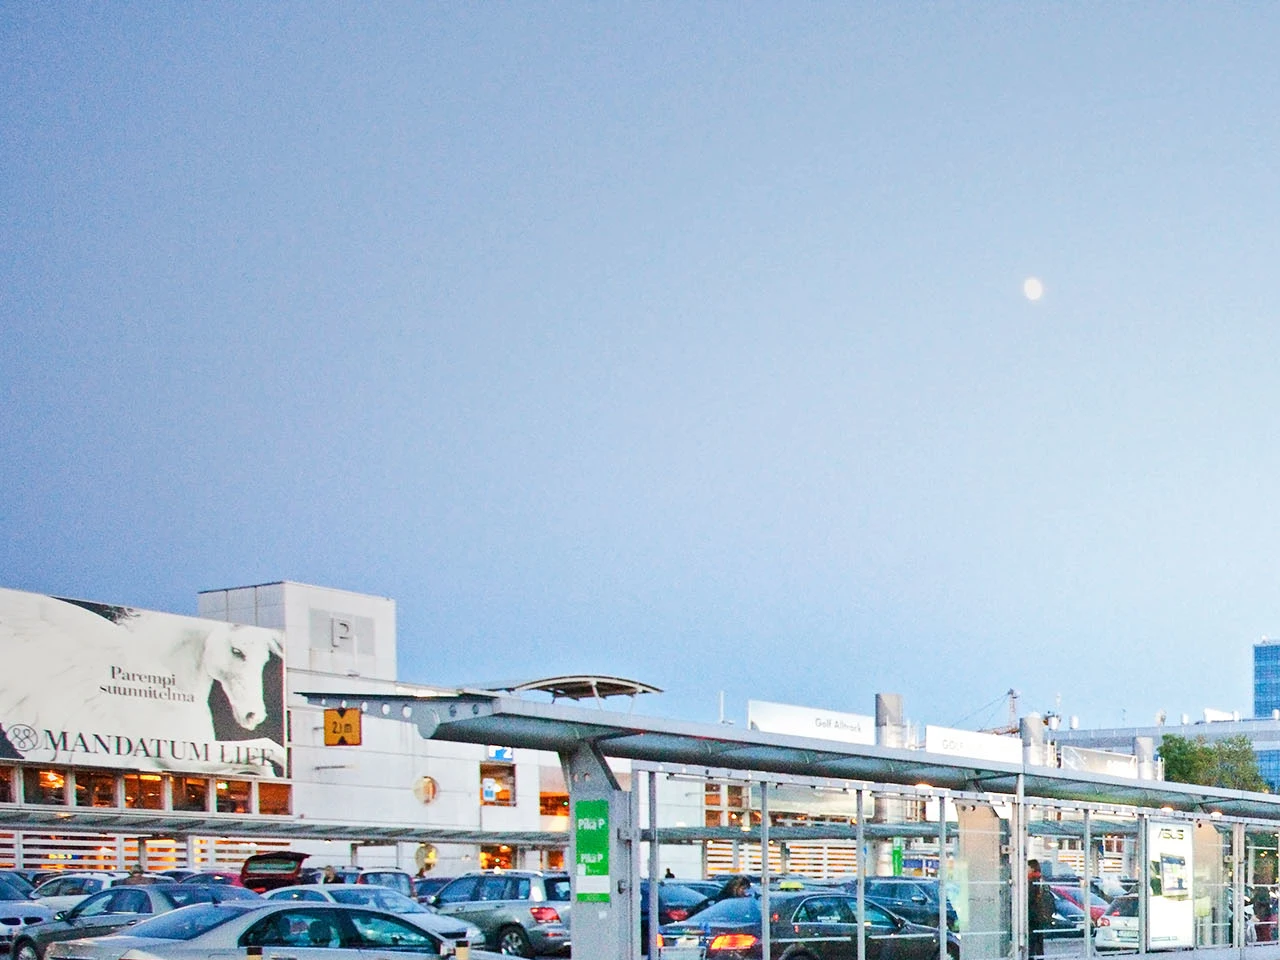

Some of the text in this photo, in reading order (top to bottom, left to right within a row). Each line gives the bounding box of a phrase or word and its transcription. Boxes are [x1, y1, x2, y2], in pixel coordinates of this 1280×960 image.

[110, 665, 176, 686] Parempi
[99, 685, 195, 703] suunnitelma
[44, 729, 275, 767] MANDATUM LIFE
